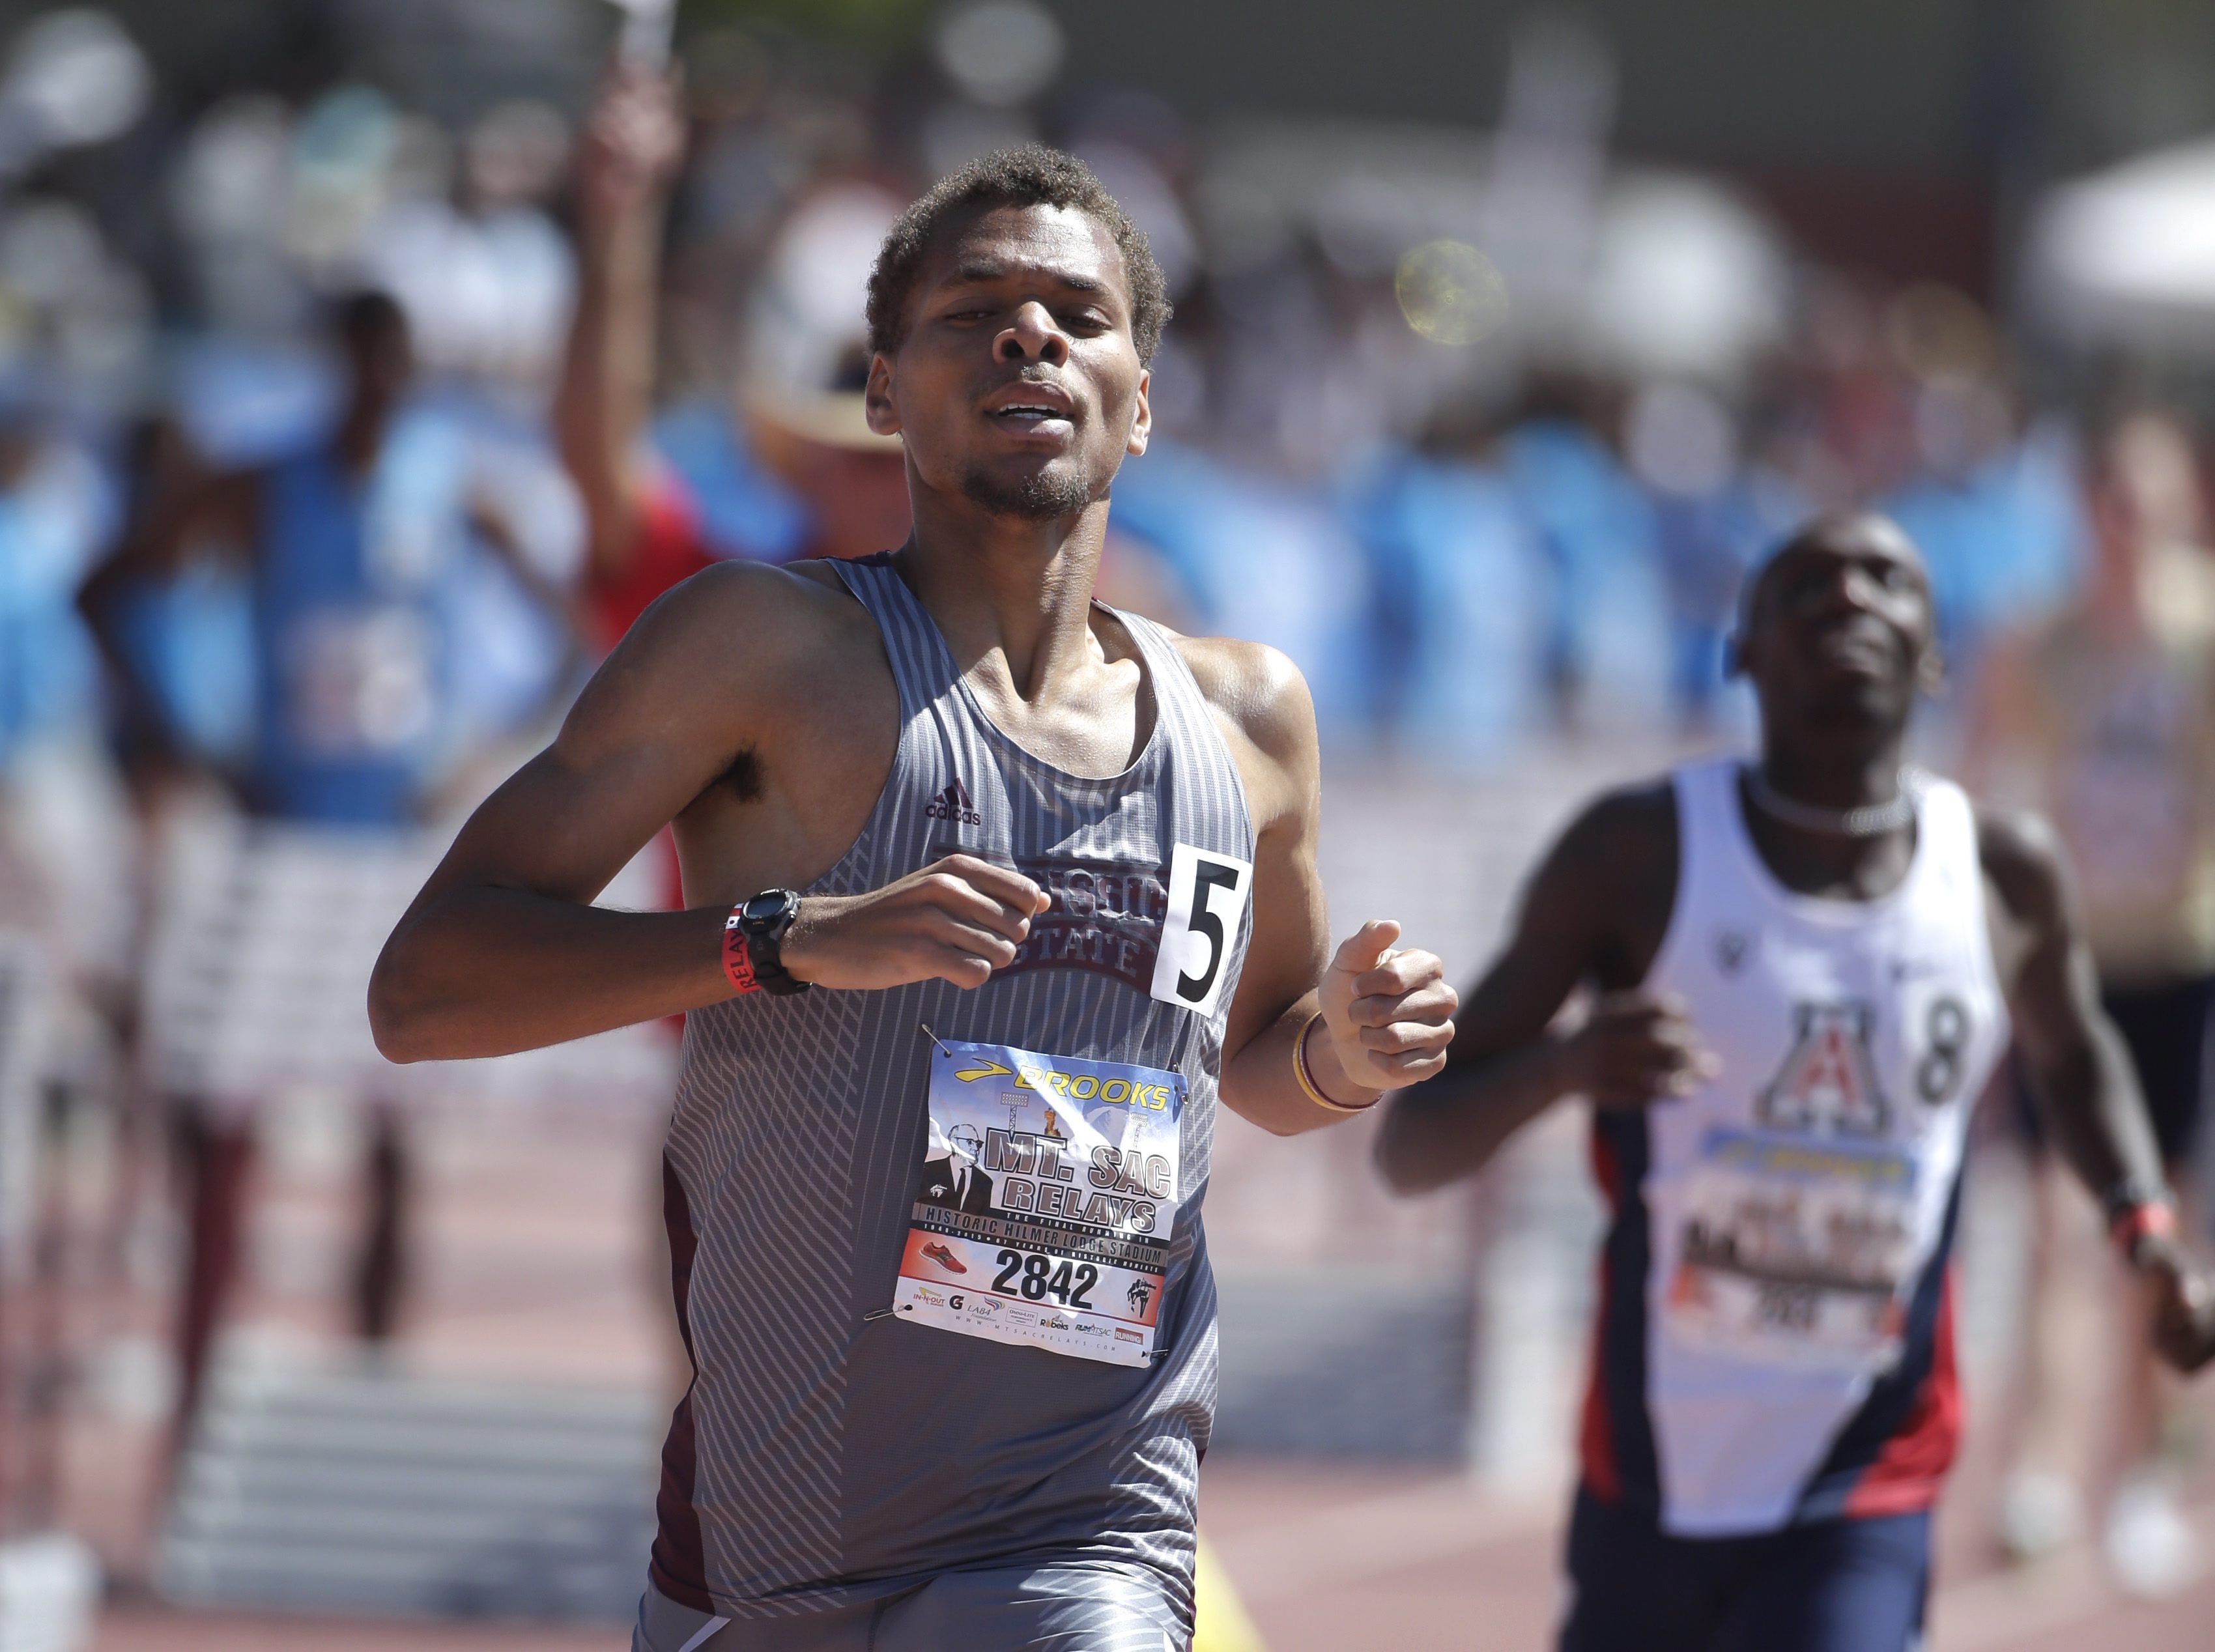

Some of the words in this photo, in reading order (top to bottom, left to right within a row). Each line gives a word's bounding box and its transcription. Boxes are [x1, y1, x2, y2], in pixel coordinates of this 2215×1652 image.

[926, 802, 980, 825] adidas
[1175, 859, 1240, 1003] 5
[1915, 997, 1973, 1106] 8
[1013, 1065, 1170, 1111] BROOKS
[984, 1127, 1074, 1182] MT.
[1088, 1145, 1171, 1199] SAC
[1001, 1176, 1156, 1234] RELAYS
[1007, 1212, 1029, 1222] THE
[1040, 1219, 1073, 1230] FINAL
[926, 1207, 998, 1233] HISTORIC
[1004, 1222, 1059, 1244] HILMER
[1063, 1234, 1106, 1253] LODGE
[1109, 1242, 1162, 1264] STADIUM
[991, 1249, 1098, 1309] 2842
[967, 1304, 992, 1316] LA84
